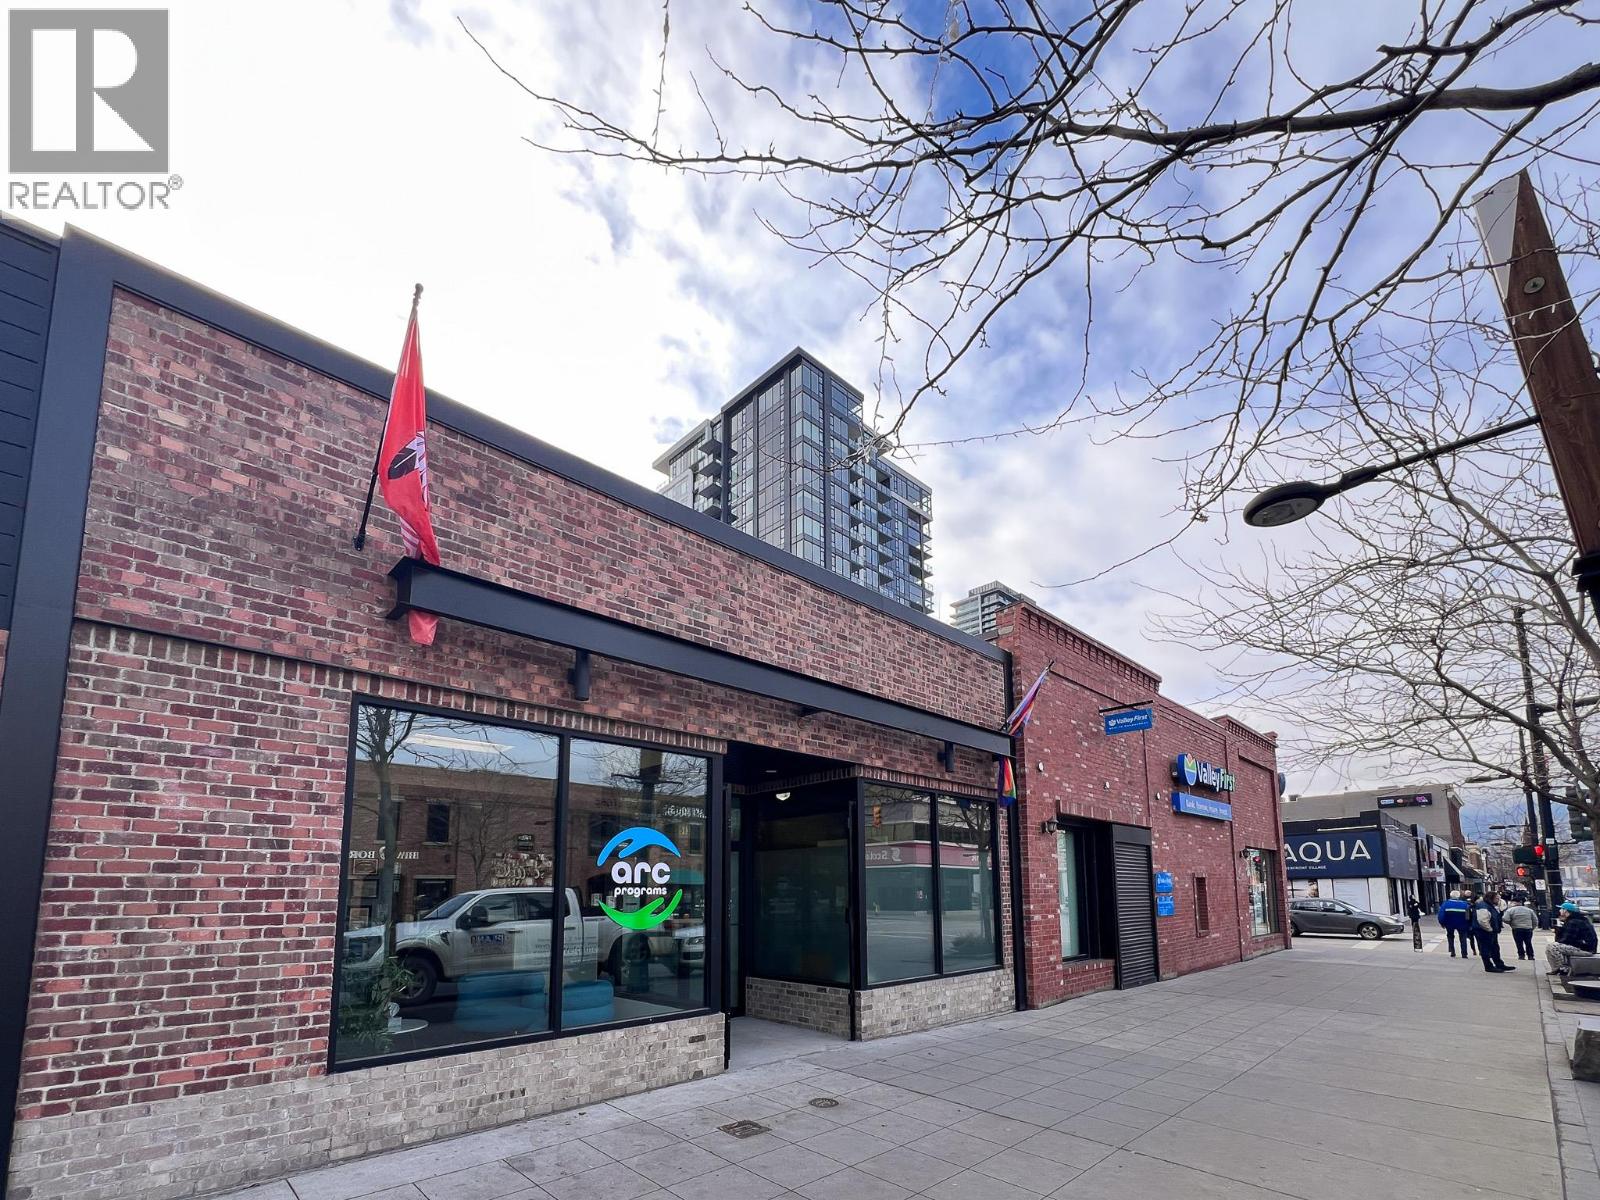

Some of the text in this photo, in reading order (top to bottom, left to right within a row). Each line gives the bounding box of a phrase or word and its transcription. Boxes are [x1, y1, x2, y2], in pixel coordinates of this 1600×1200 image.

[1197, 760, 1220, 792] Valley
[1284, 839, 1371, 863] AQUA
[611, 861, 671, 884] arc
[614, 887, 668, 898] programs
